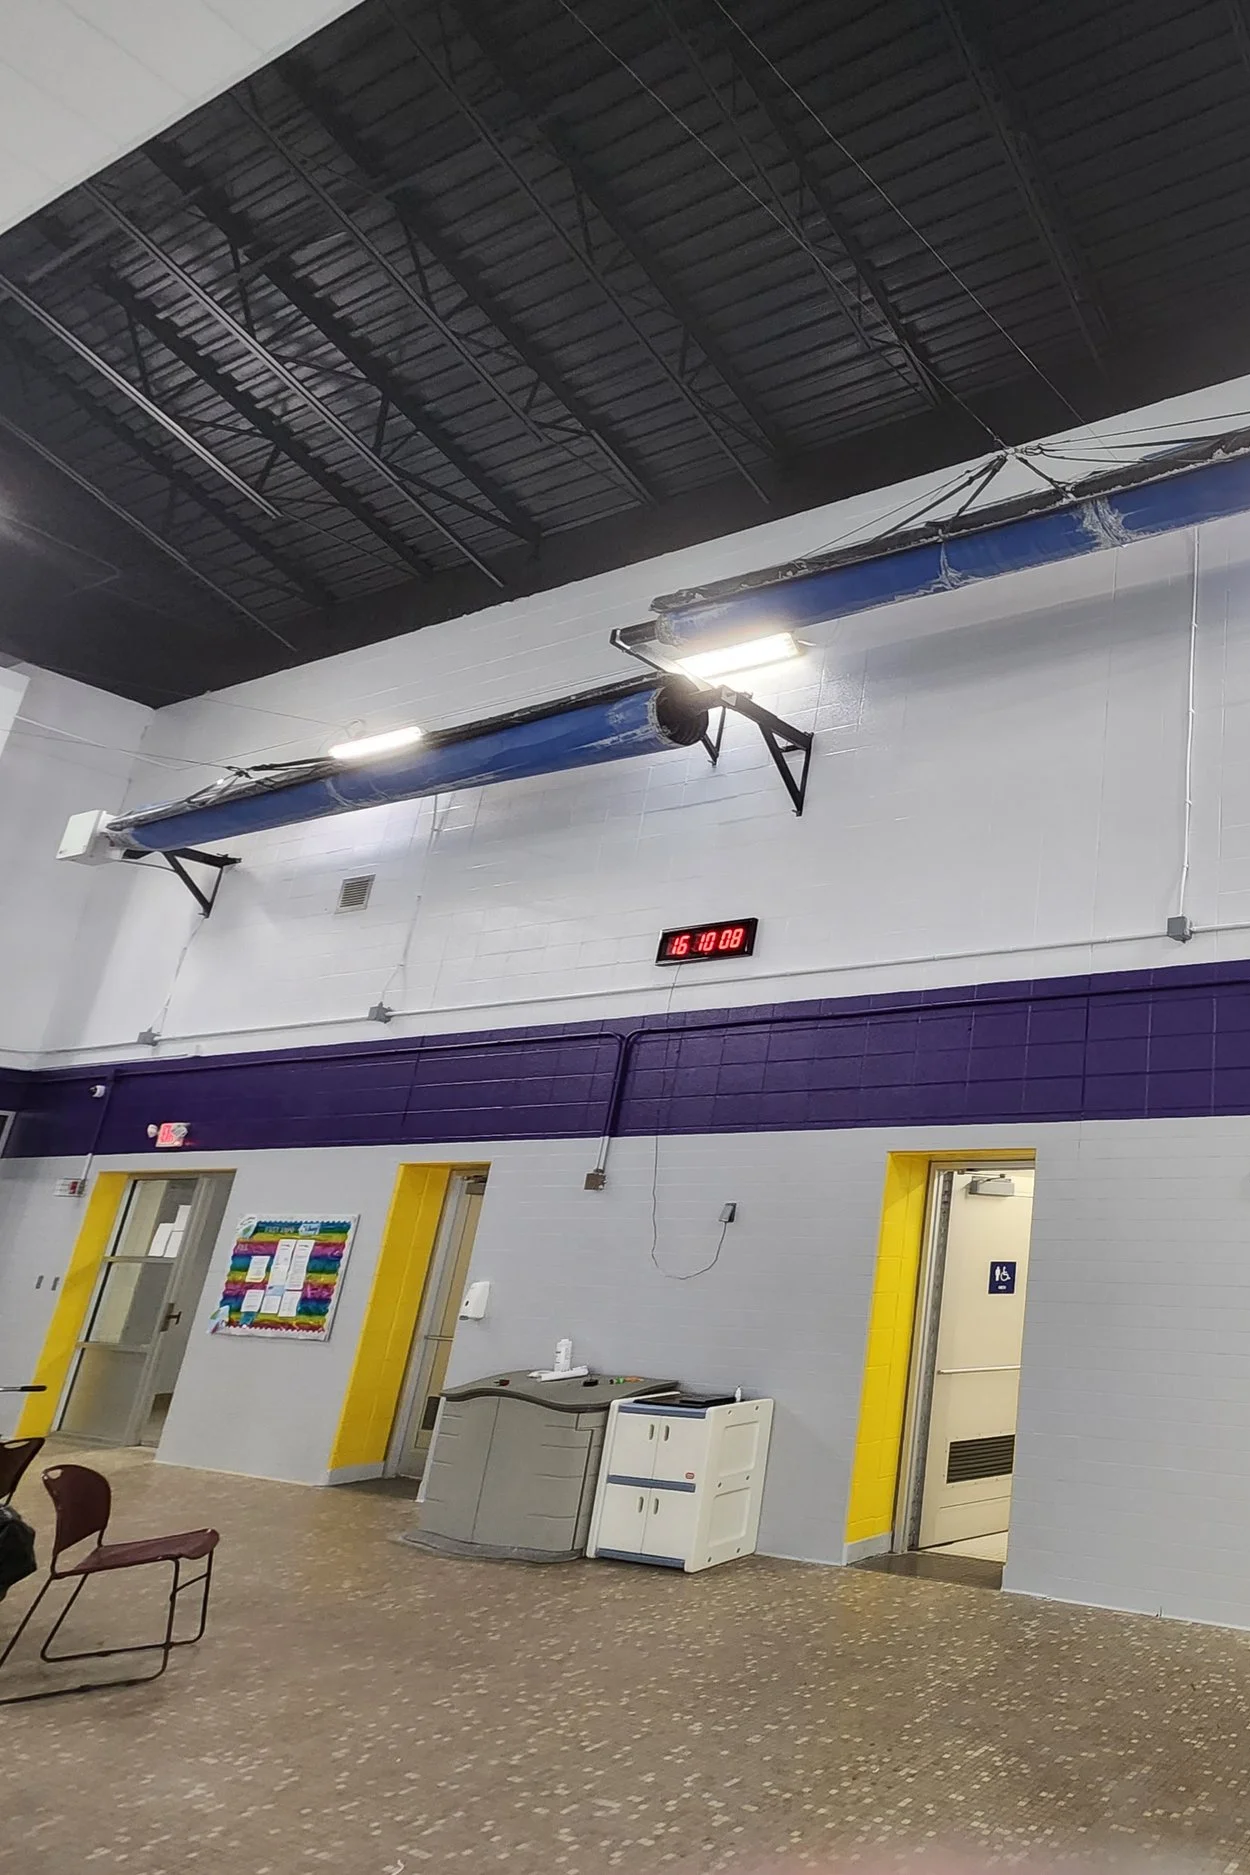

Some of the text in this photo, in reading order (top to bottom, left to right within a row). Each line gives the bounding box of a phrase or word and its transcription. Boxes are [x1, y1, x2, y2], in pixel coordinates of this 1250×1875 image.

[672, 928, 744, 955] 16 10 08
